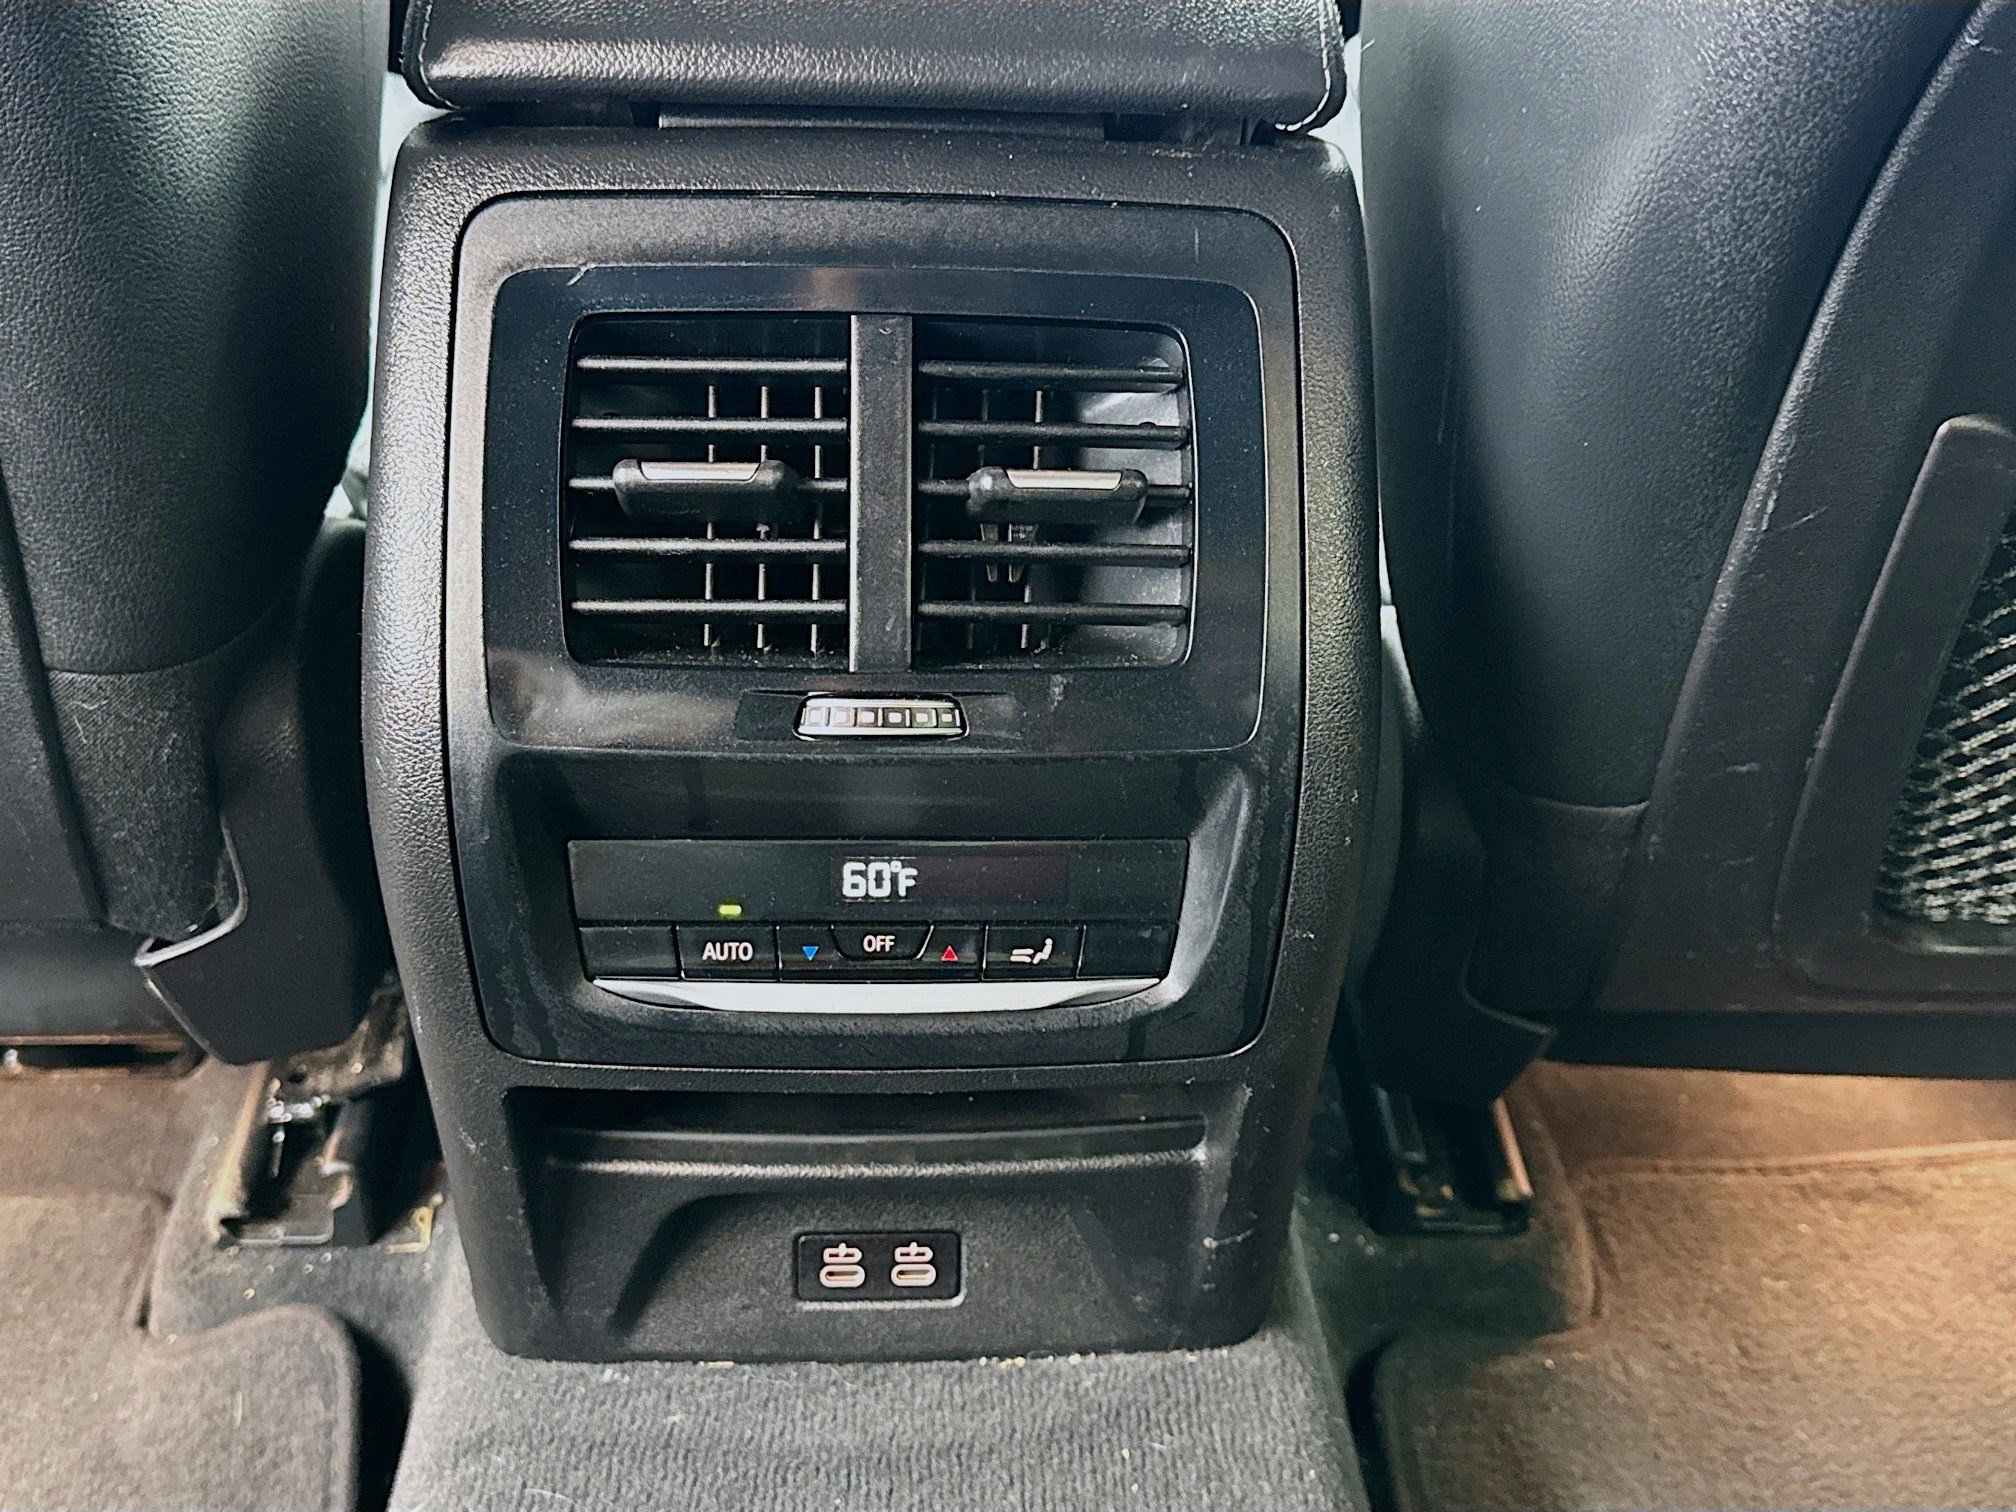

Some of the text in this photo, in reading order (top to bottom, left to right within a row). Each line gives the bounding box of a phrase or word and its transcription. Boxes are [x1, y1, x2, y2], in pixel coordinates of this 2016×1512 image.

[842, 860, 918, 897] 60°F
[702, 941, 753, 961] AUTO
[863, 935, 895, 952] OFF
